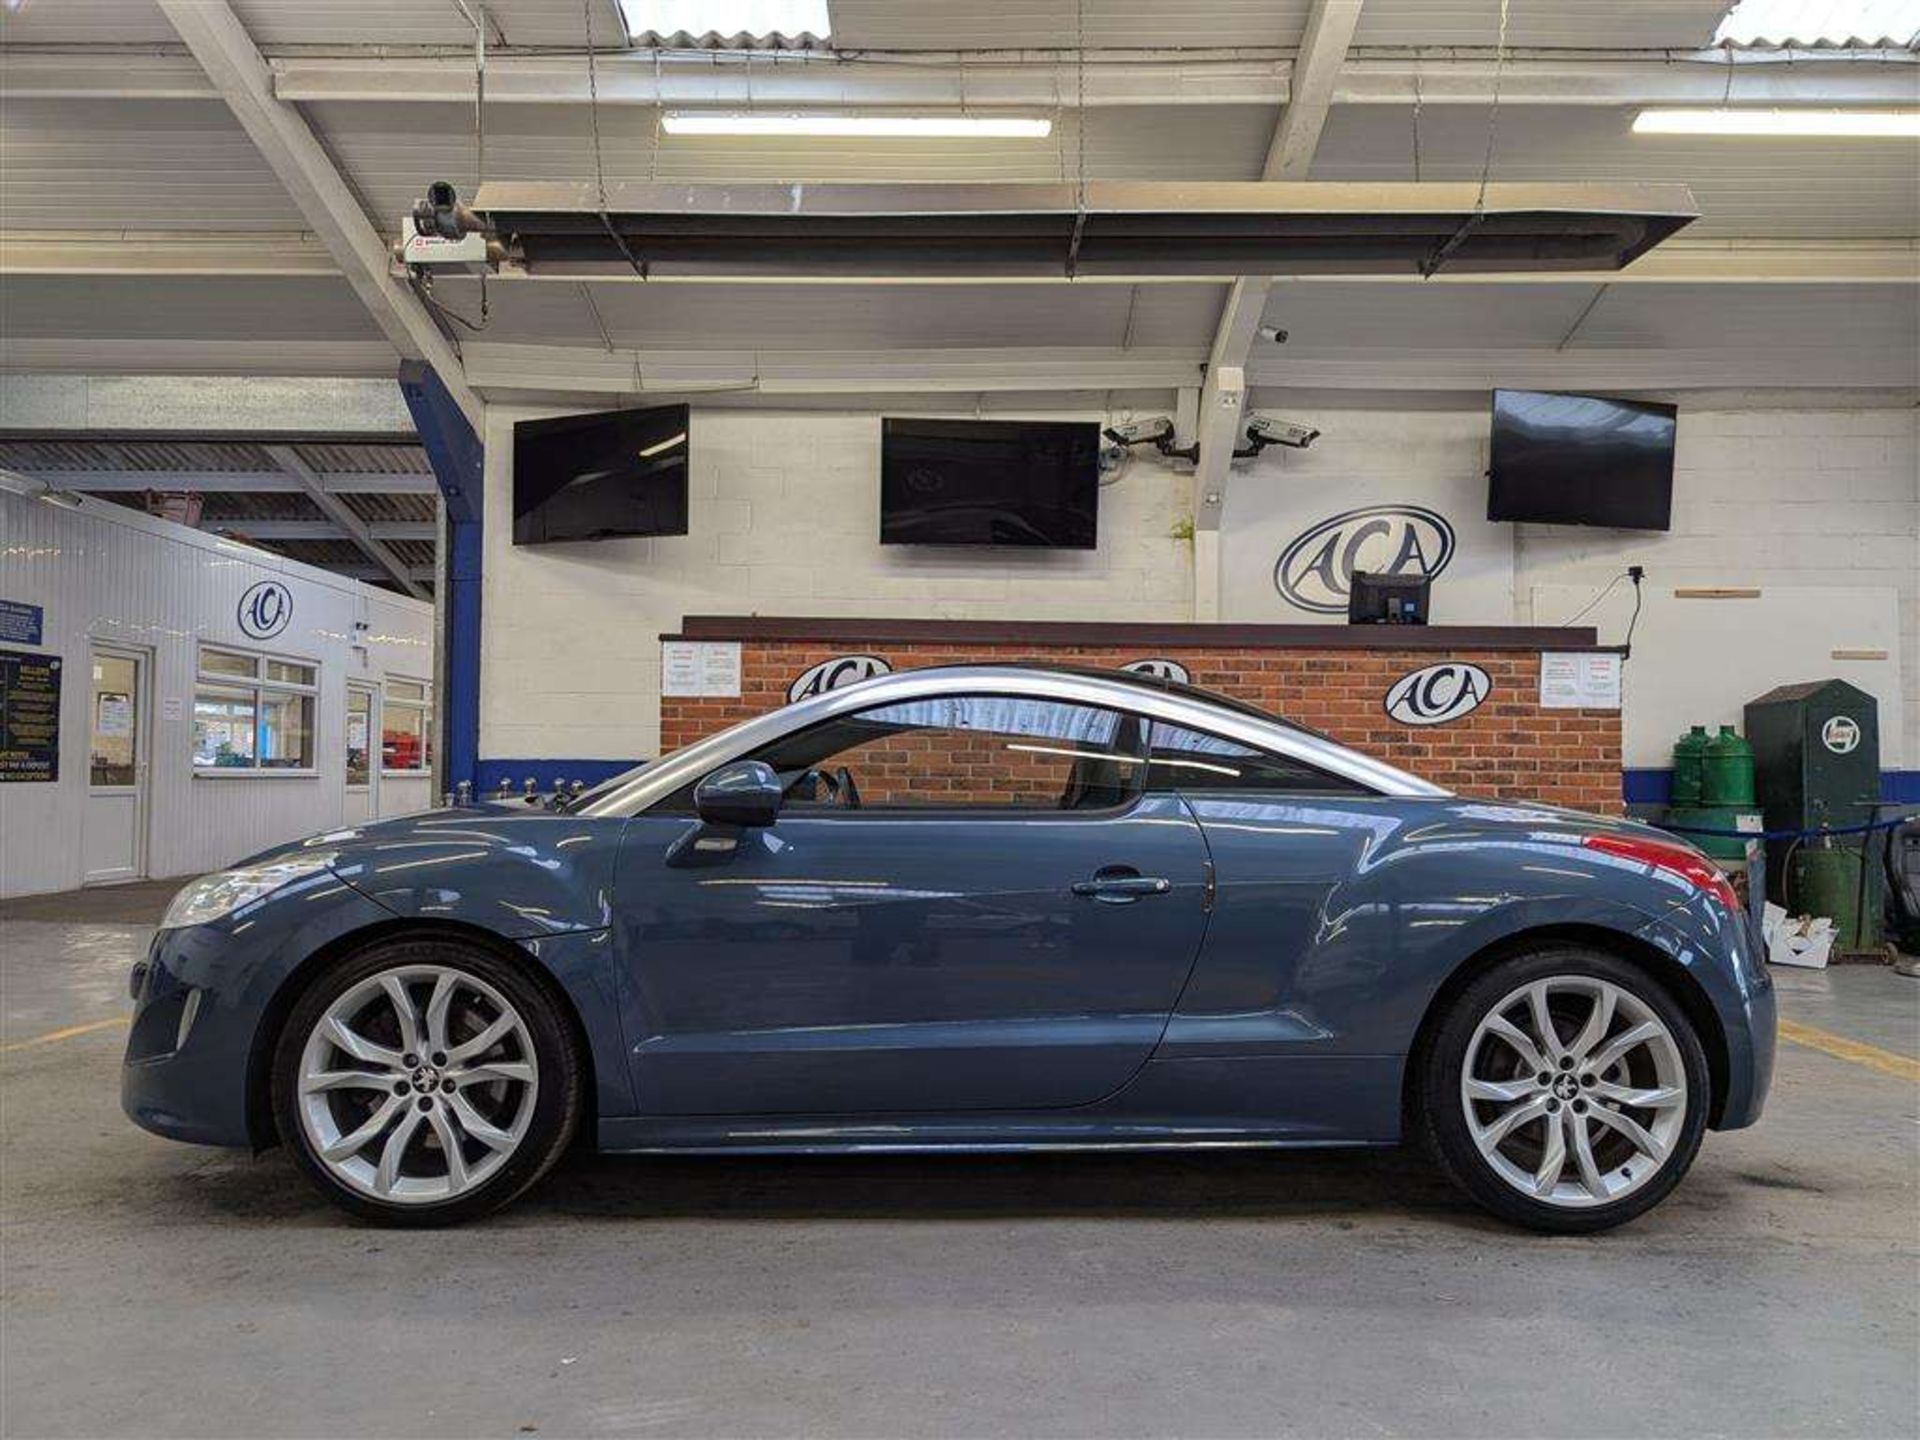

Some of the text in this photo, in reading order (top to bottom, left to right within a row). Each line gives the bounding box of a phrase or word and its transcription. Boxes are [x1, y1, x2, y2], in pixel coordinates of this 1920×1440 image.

[1290, 518, 1430, 595] ACA
[244, 587, 286, 630] ACA
[1388, 667, 1481, 718] ACA
